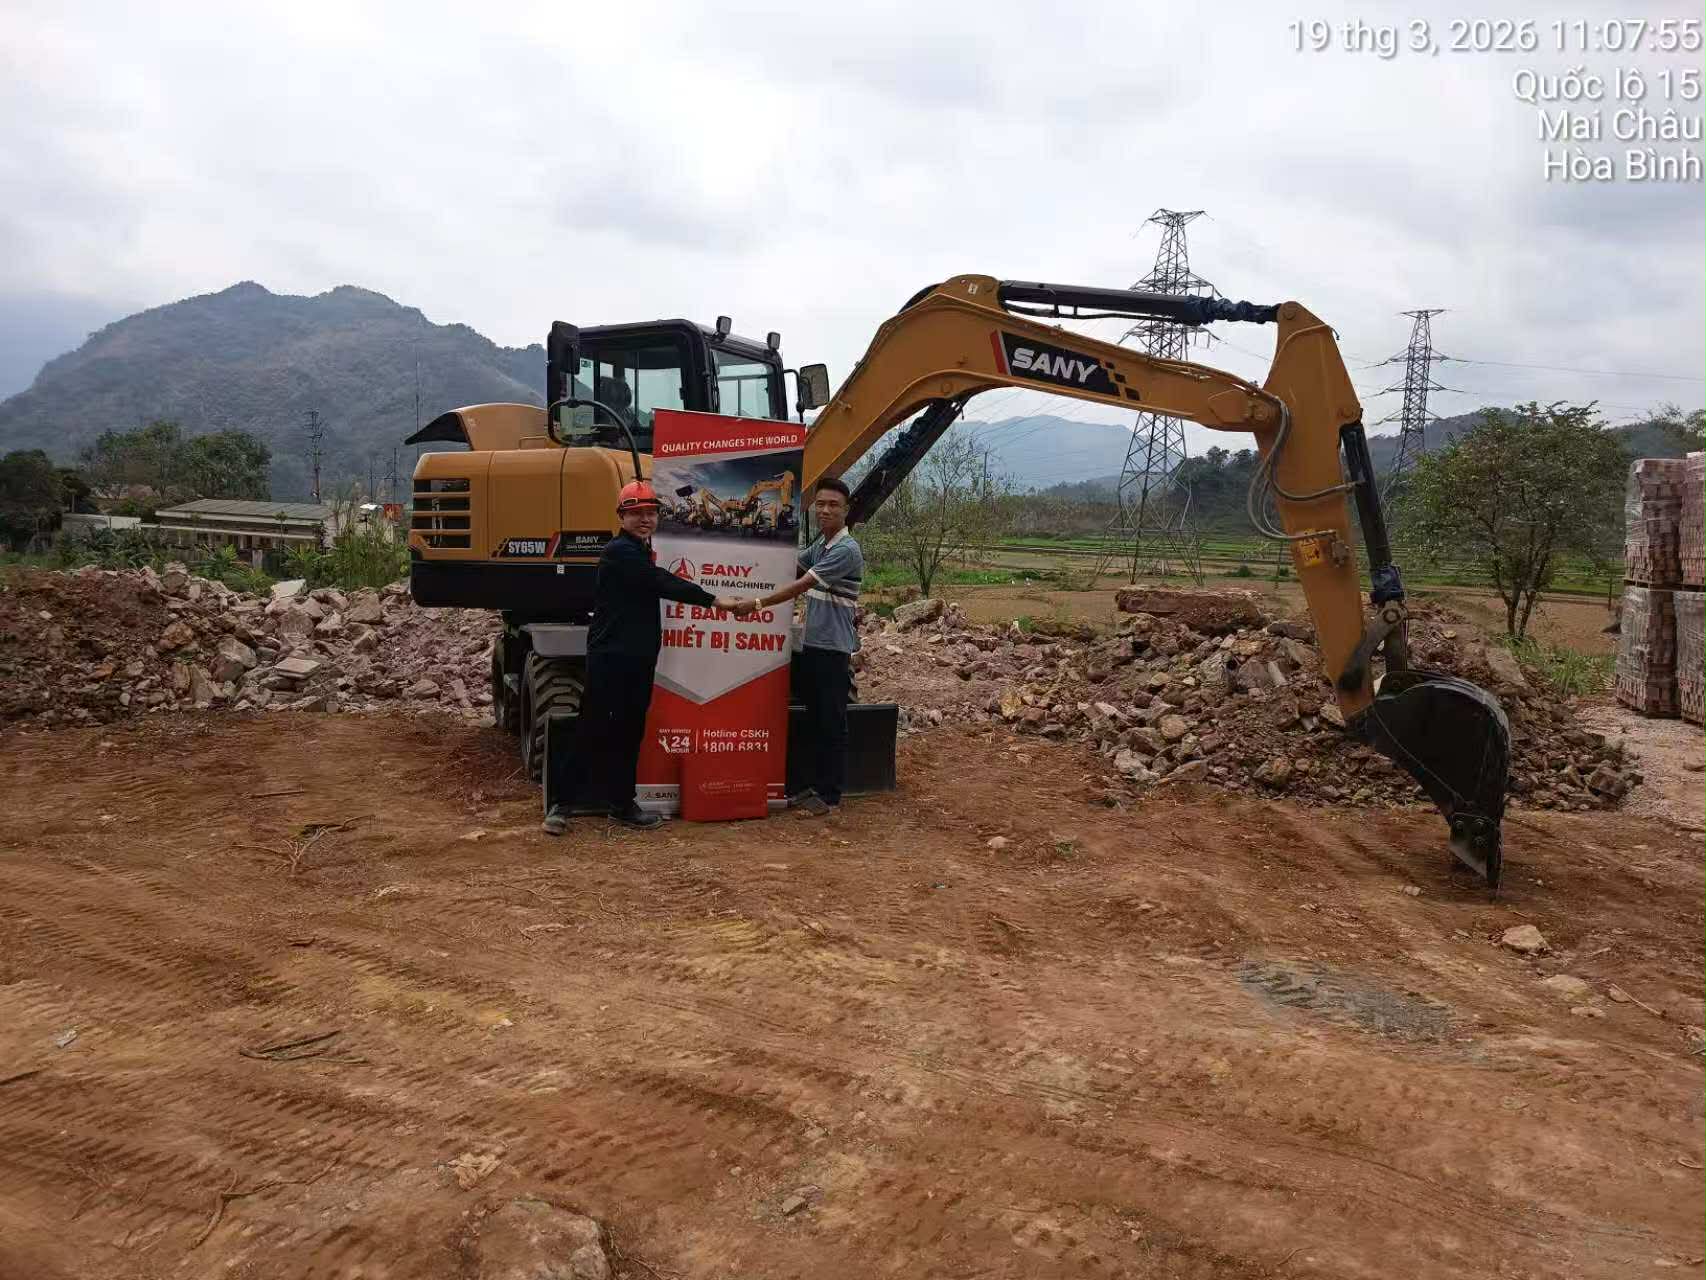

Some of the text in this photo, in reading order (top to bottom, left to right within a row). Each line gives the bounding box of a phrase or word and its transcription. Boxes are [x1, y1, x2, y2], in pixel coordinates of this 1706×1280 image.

[1011, 347, 1099, 384] SANY
[661, 434, 798, 453] QUALITY CHANGES THE WORLD
[508, 541, 546, 554] SY65W
[701, 563, 753, 578] SANY
[700, 578, 776, 591] FULI MACHINERY
[662, 624, 786, 653] HIẾT BỊ SANY
[703, 729, 769, 738] Hotline CSKH
[671, 735, 691, 748] 24
